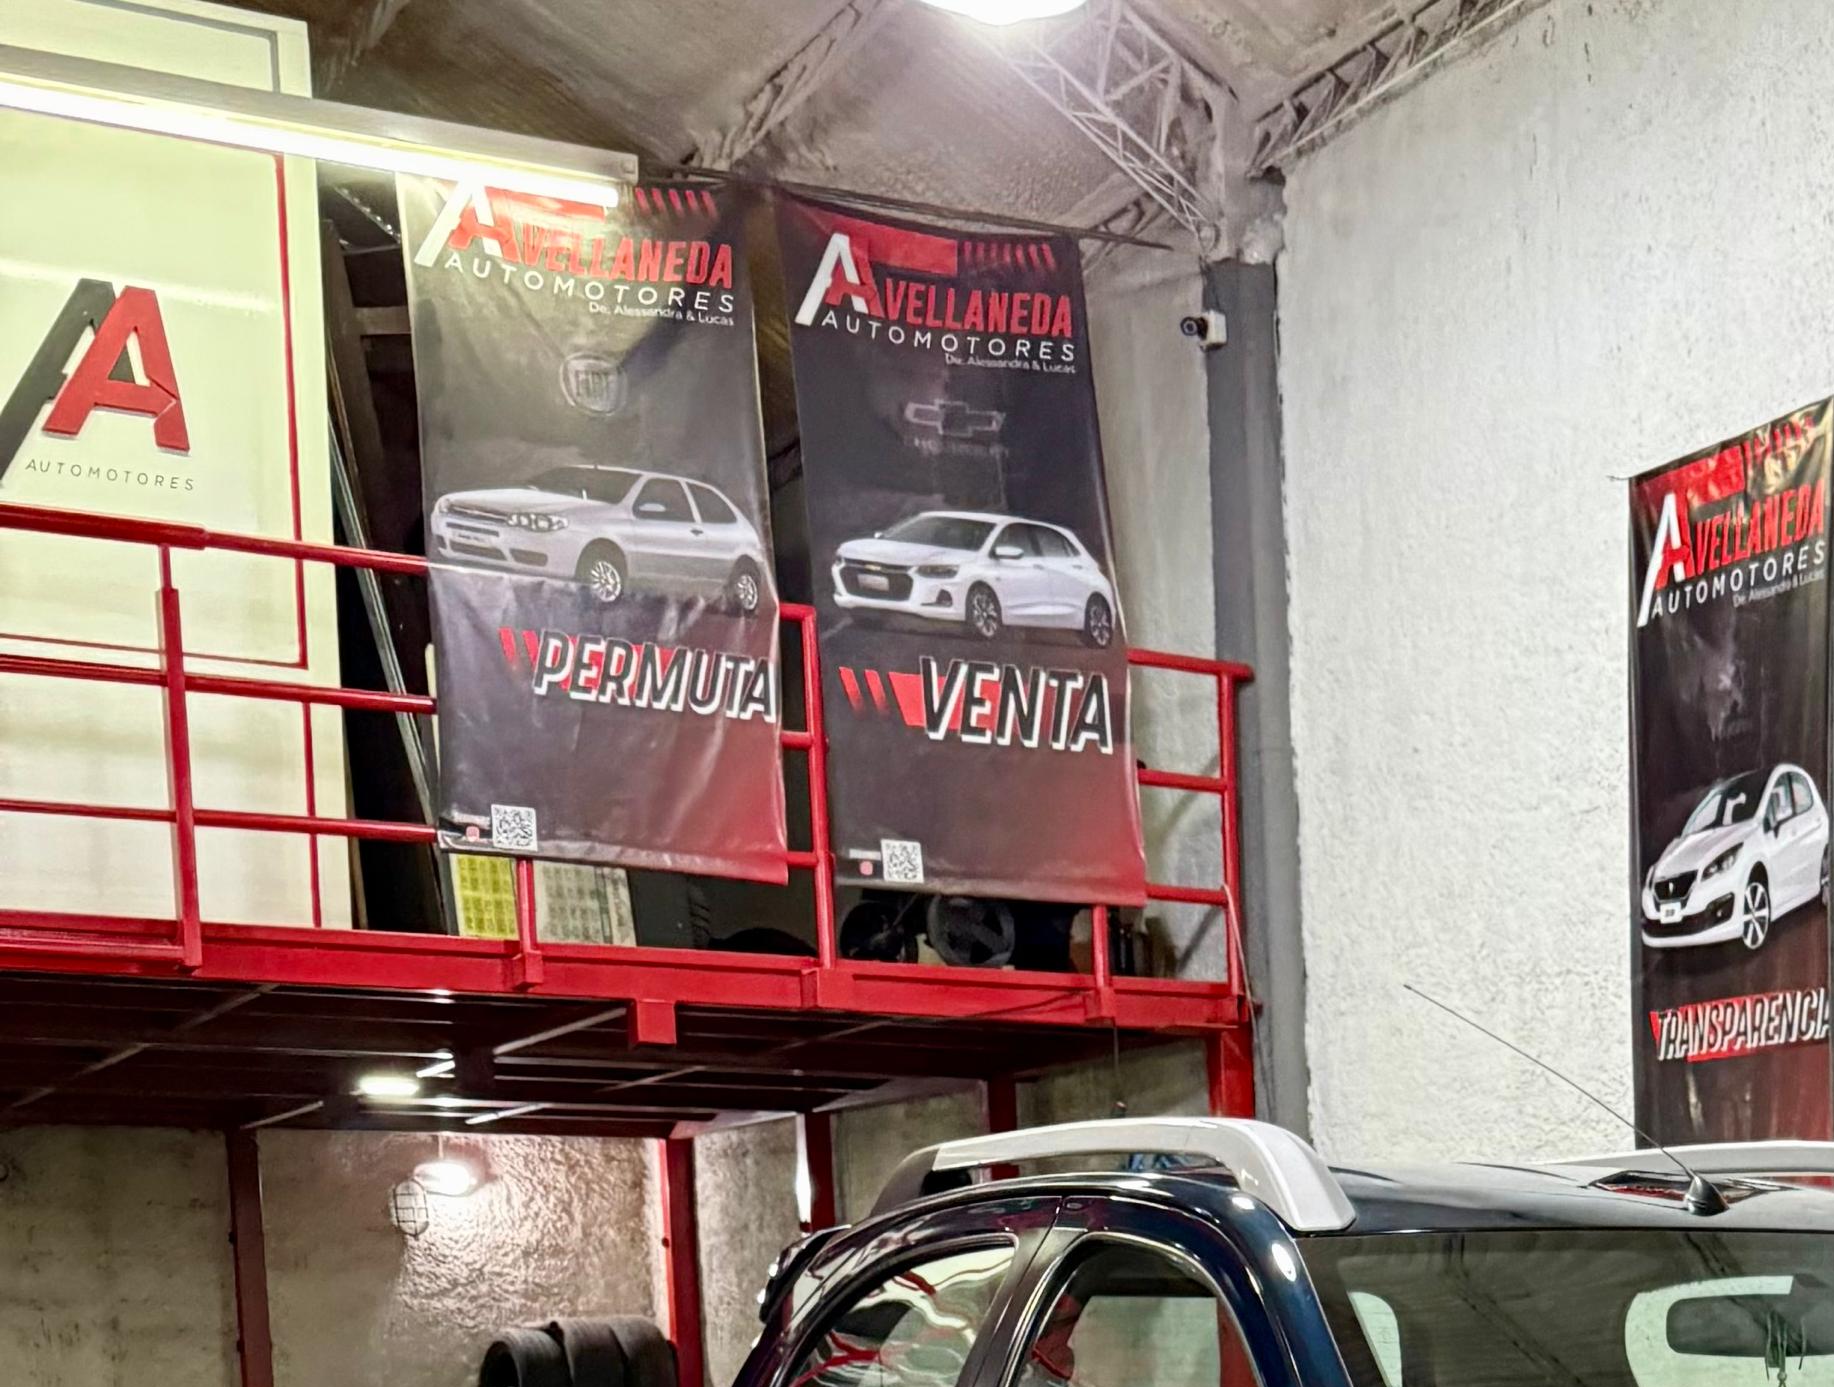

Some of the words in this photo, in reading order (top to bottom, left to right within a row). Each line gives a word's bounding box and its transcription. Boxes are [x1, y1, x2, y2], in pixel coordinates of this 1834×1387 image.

[414, 180, 734, 289] AVELLANEDA
[445, 252, 735, 313] AUTOMOTORES
[686, 311, 696, 322] &
[698, 311, 735, 326] Lucas
[795, 232, 1073, 338] AVELLANEDA
[821, 310, 1075, 362] AUTOMOTORES
[25, 458, 194, 491] AUTOMOTORES
[1637, 479, 1825, 628] AVELLANEDA
[1651, 540, 1826, 620] AUTOMOTORES
[532, 628, 777, 723] PERMUTA
[919, 655, 1114, 755] VENTA
